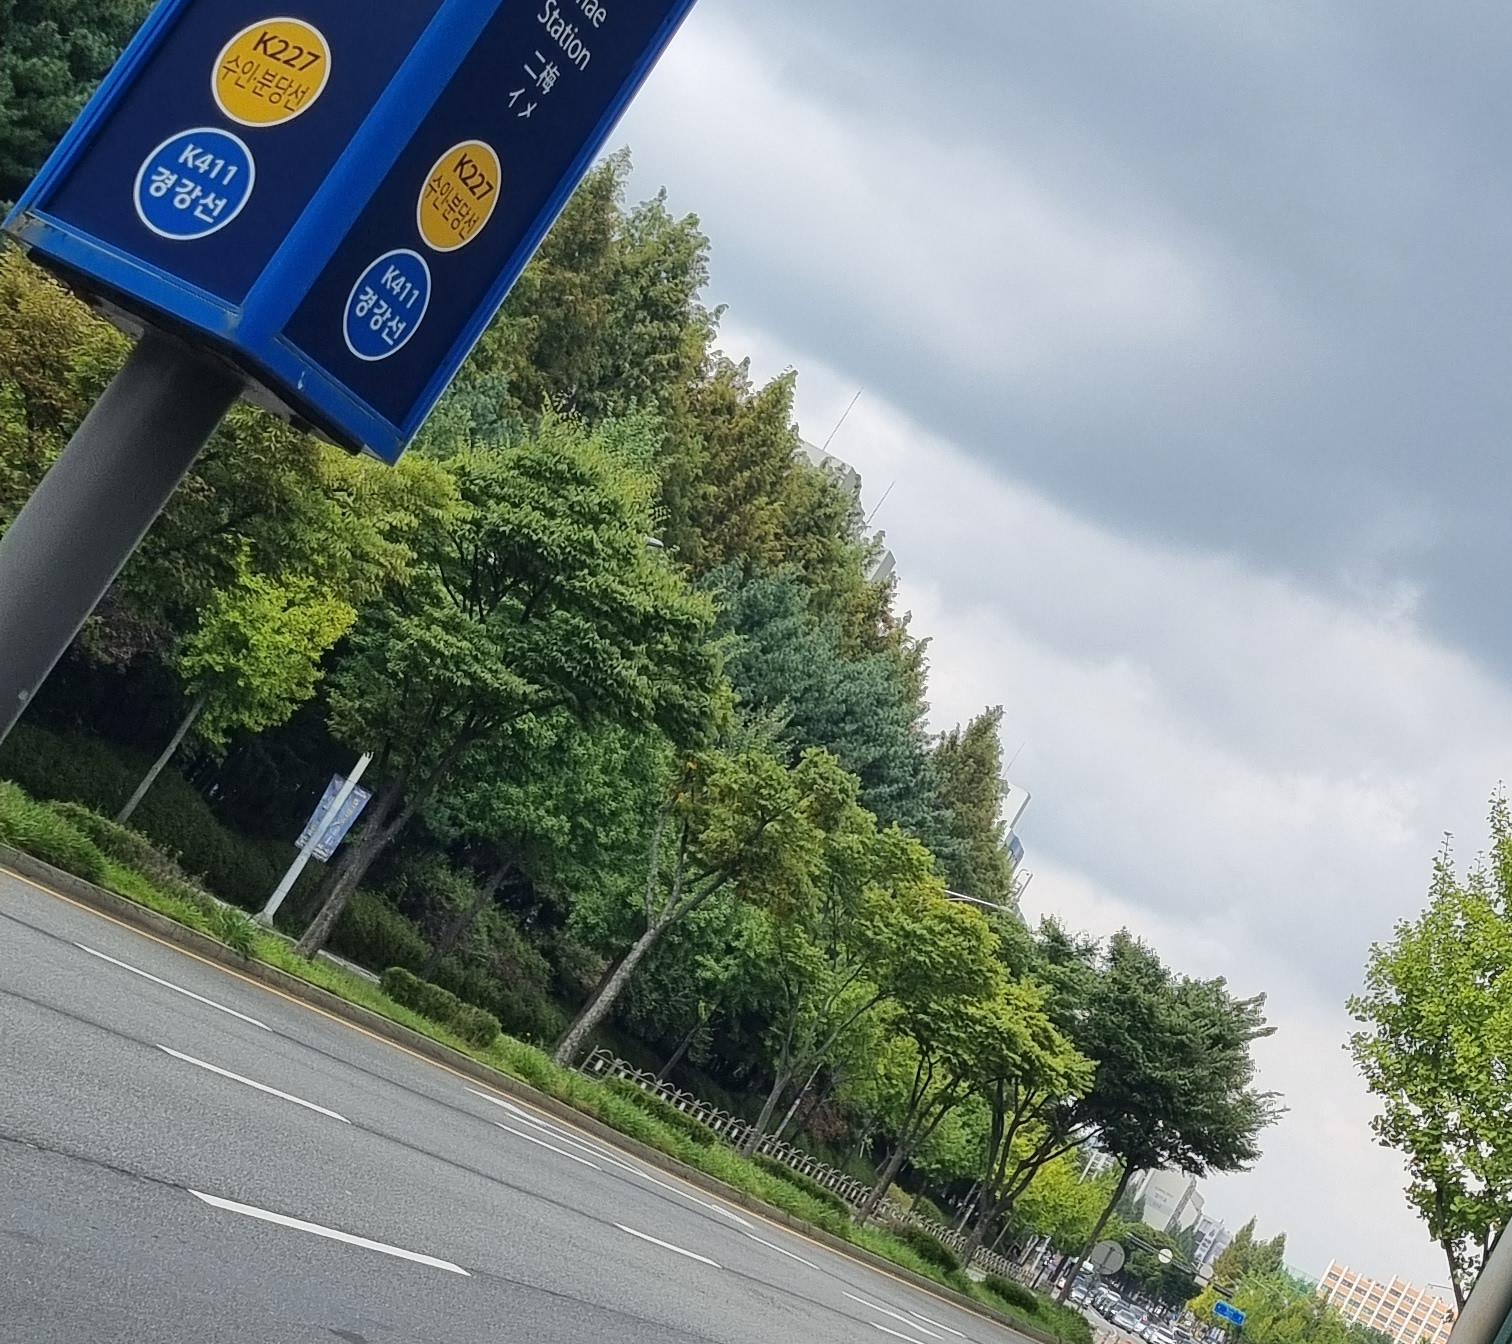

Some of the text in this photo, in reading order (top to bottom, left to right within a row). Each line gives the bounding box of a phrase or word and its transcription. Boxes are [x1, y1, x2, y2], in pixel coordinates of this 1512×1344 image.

[252, 32, 321, 74] K227
[523, 50, 560, 95] 二梅
[508, 87, 538, 119] イメ
[177, 142, 238, 186] K411
[453, 153, 495, 201] K227
[147, 165, 228, 224] 경강선
[380, 264, 420, 308] K411
[355, 286, 407, 345] 경강선
